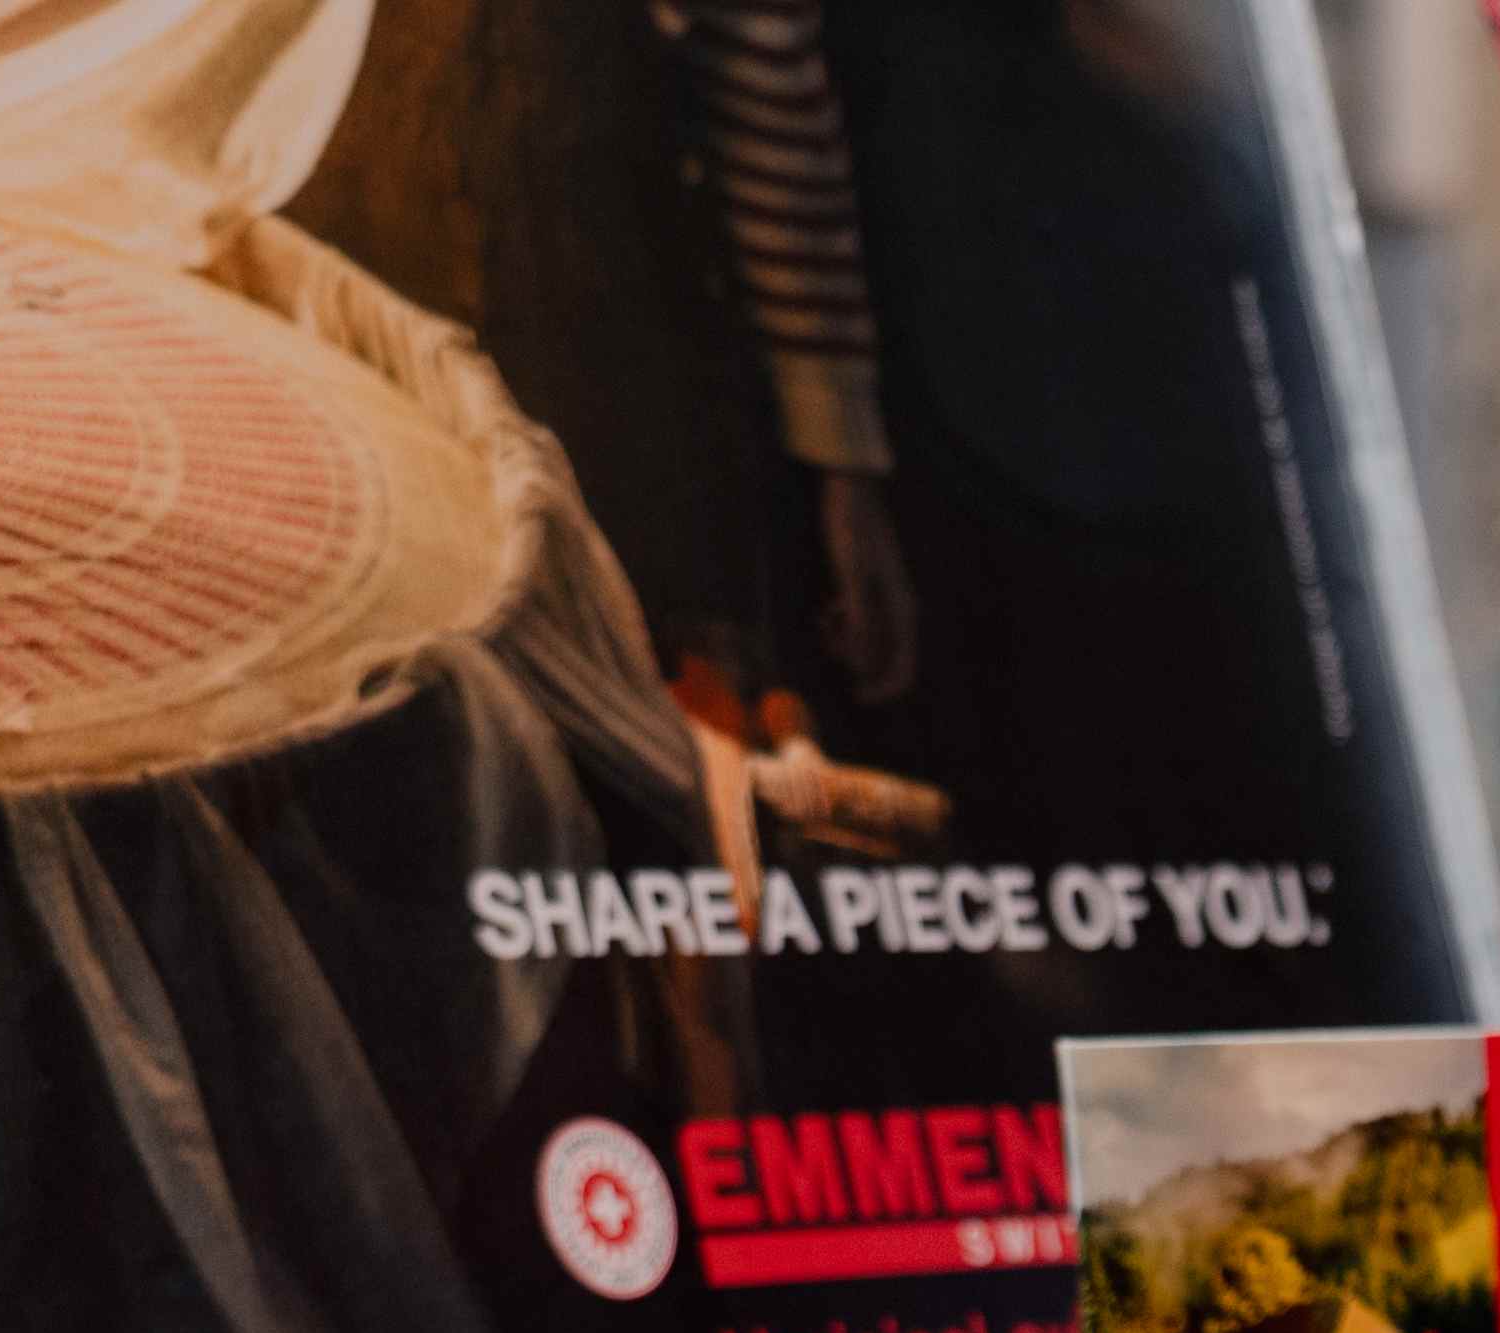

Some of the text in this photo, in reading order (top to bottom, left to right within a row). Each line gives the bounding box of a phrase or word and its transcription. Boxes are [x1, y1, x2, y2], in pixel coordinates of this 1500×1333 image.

[469, 868, 749, 961] SHARE
[762, 870, 822, 956] A
[821, 864, 1048, 953] PIECE
[1050, 864, 1151, 951] OF
[676, 1103, 1070, 1229] EMMEN
